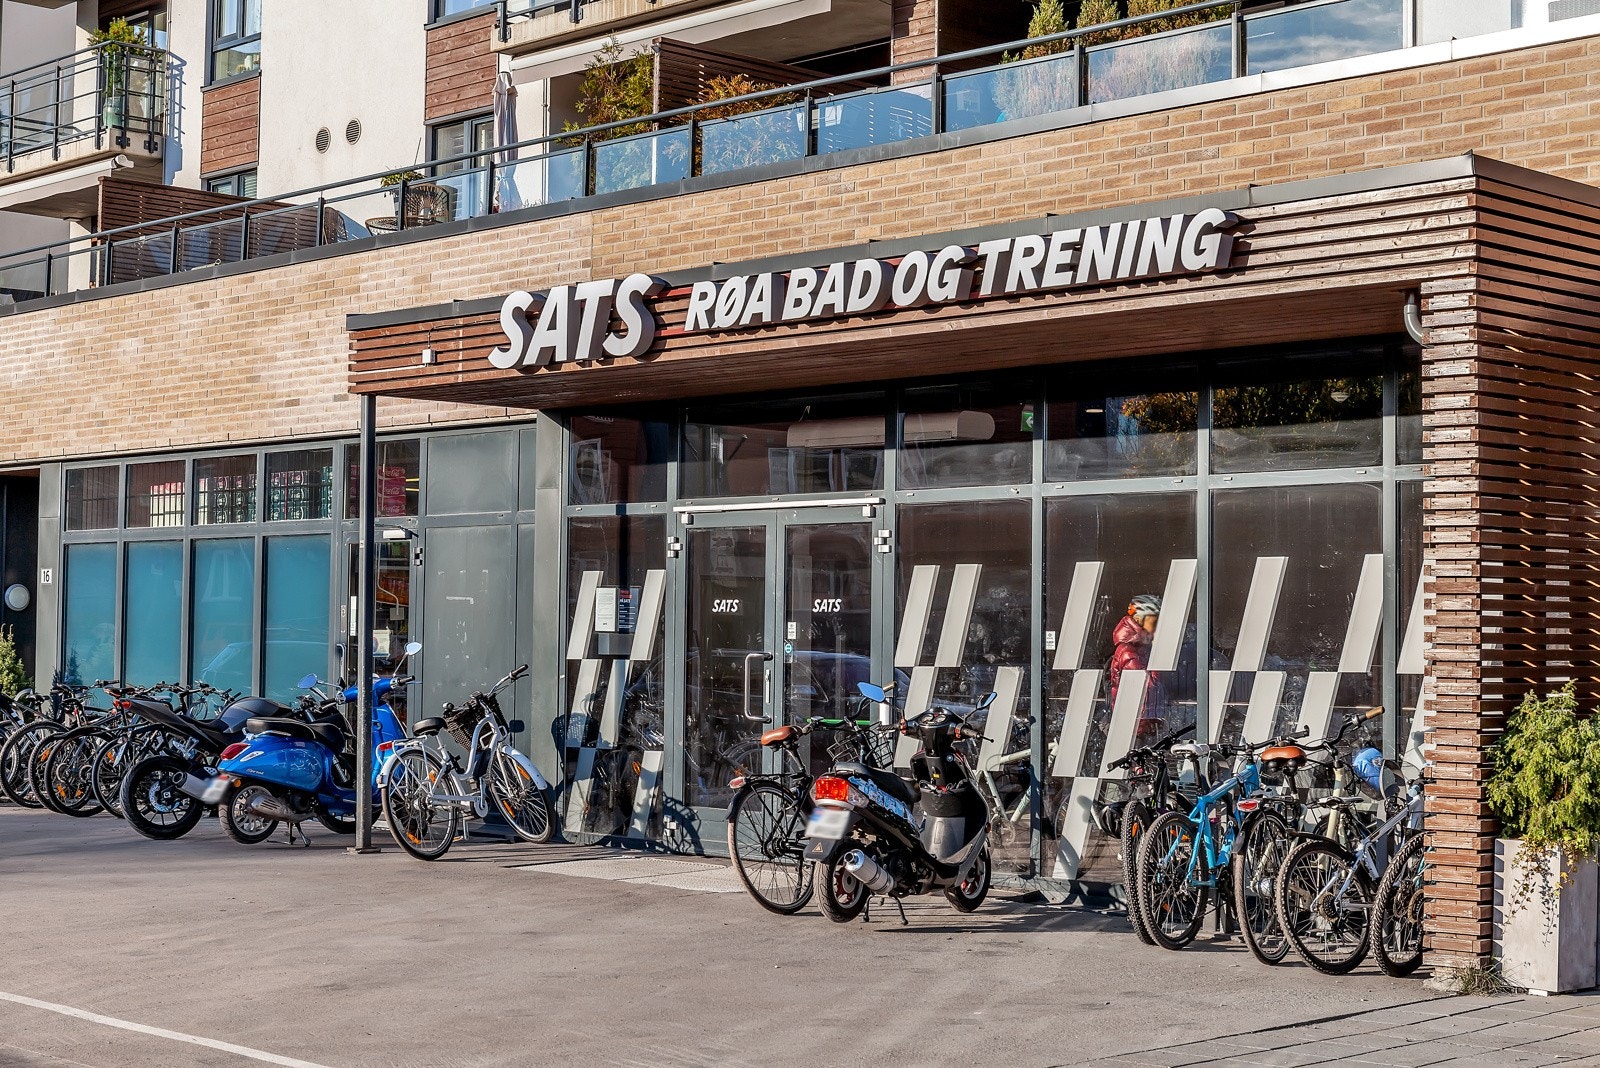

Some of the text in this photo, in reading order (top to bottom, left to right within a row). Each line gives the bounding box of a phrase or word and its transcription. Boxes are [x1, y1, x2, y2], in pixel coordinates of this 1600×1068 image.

[488, 207, 1228, 369] SATS RØA BAD OG TRENING
[43, 570, 50, 583] 16
[712, 599, 739, 613] SATS
[812, 598, 842, 613] SATS
